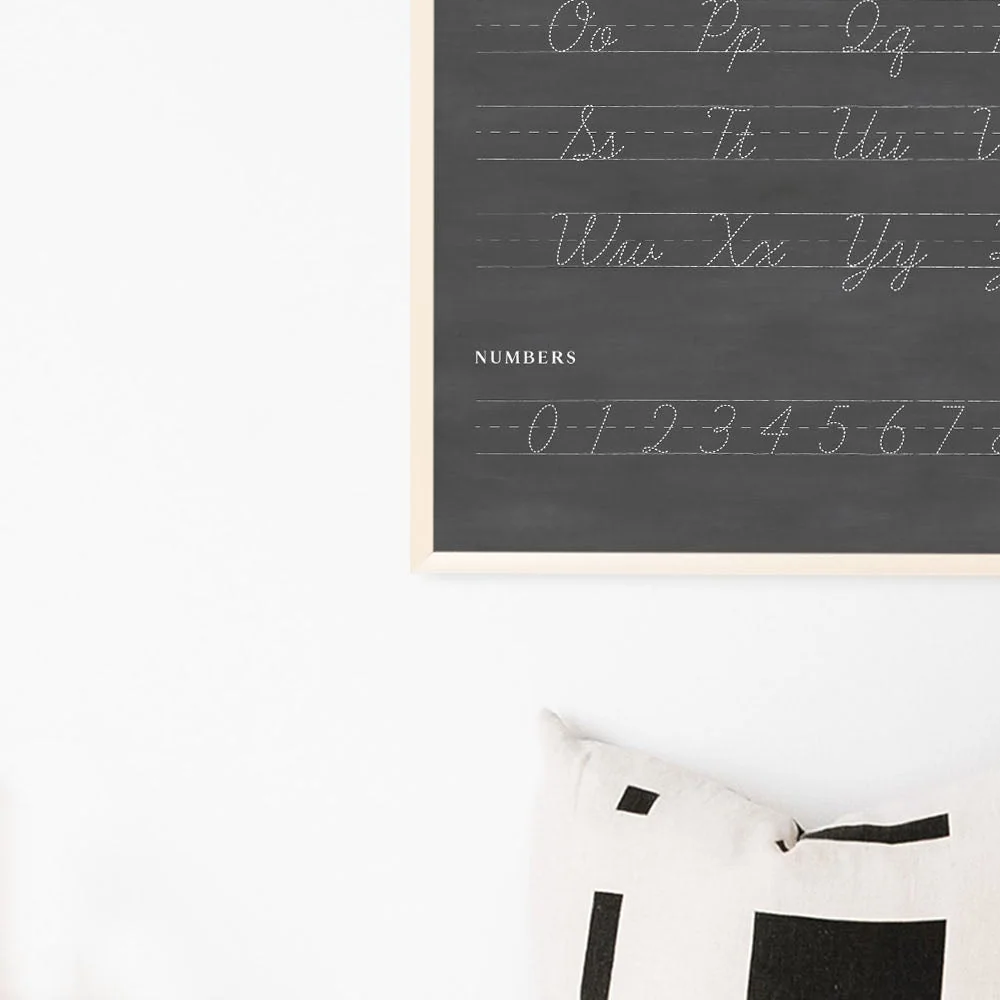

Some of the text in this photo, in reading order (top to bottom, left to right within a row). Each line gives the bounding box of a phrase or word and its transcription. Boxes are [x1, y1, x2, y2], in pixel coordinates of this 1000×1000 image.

[842, 0, 915, 78] Qq
[560, 104, 625, 161] Ss
[706, 106, 757, 160] Tt
[833, 106, 910, 160] Uu
[551, 214, 663, 267] Ww
[706, 214, 787, 267] Xx
[841, 214, 928, 293] Yy
[475, 350, 576, 365] NUMBERS
[527, 404, 558, 454] 0
[590, 404, 612, 454] 1
[641, 404, 678, 454] 2
[699, 404, 736, 454] 3
[760, 405, 793, 454] 4
[818, 405, 850, 454] 5
[879, 404, 906, 454] 6
[935, 405, 965, 455] 7
